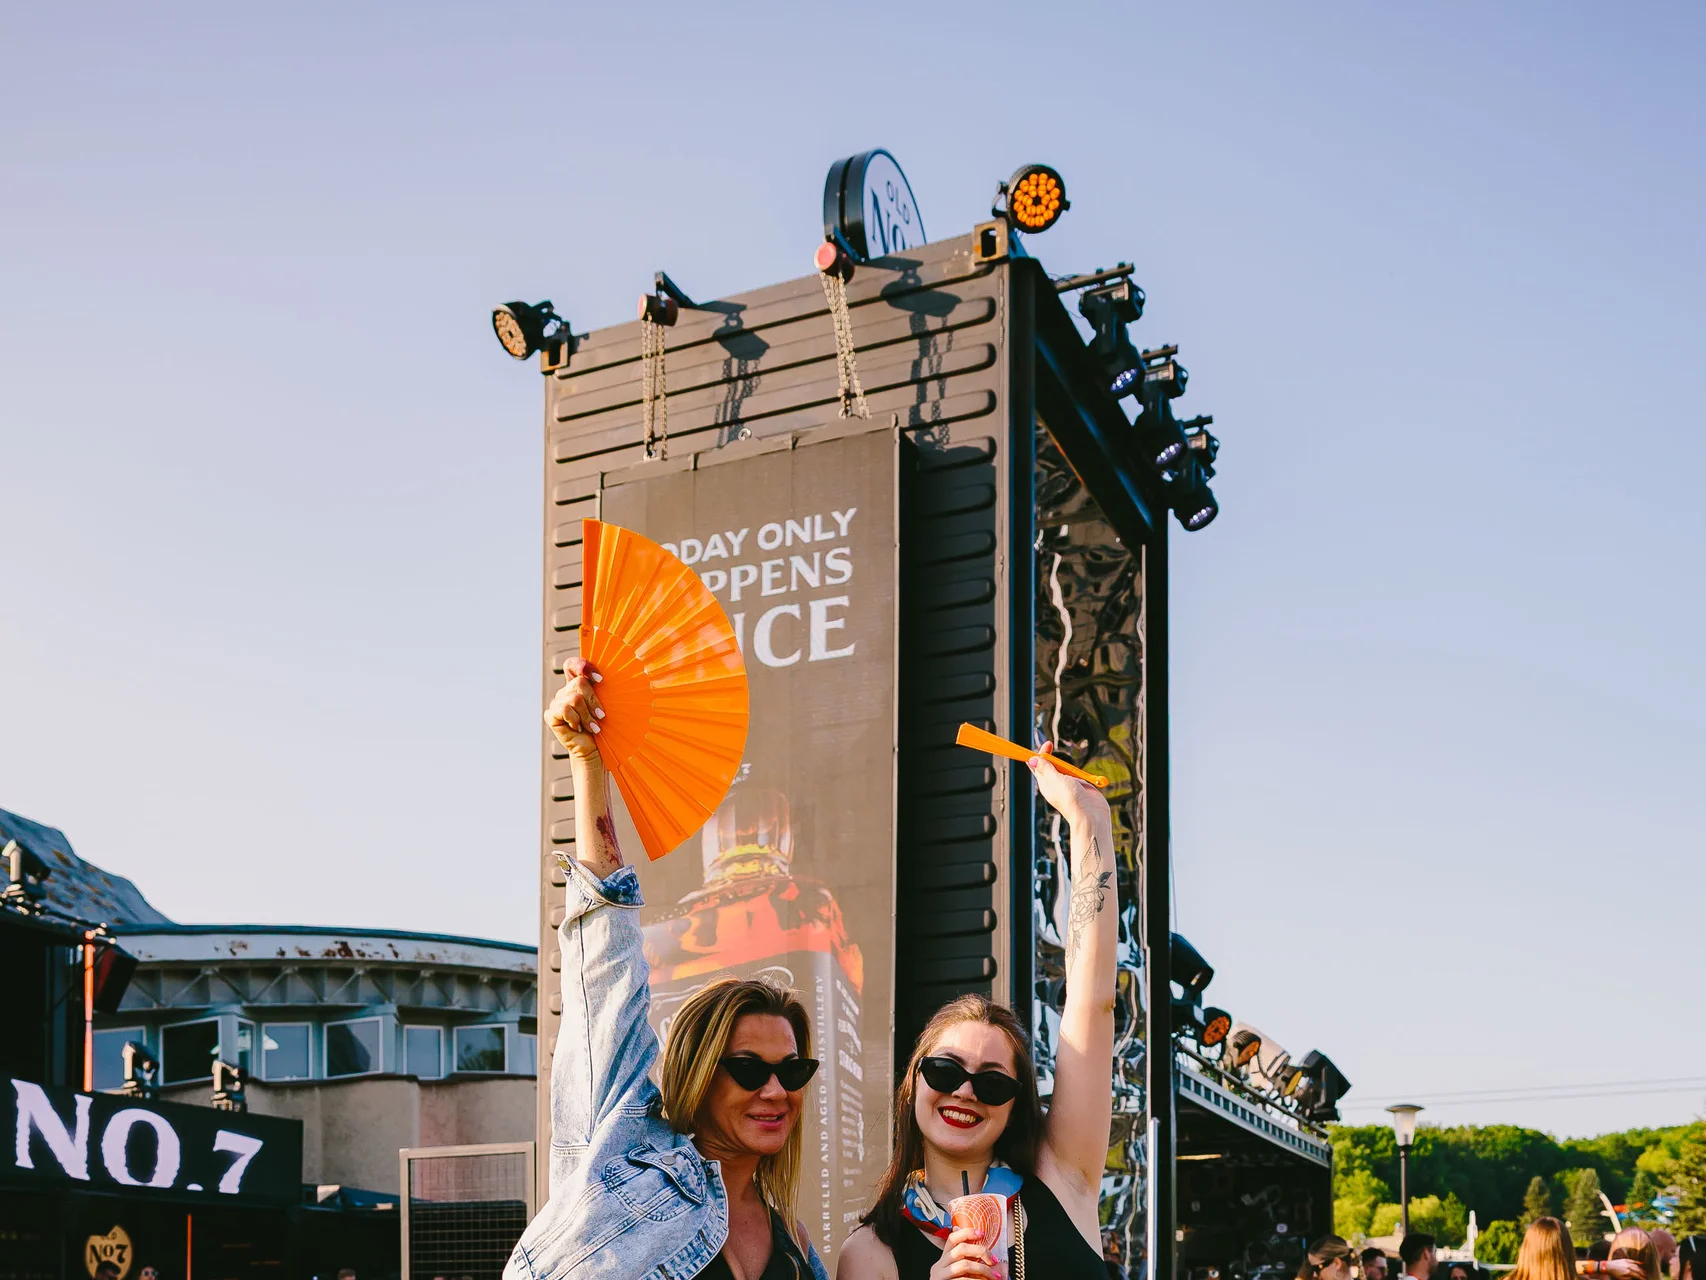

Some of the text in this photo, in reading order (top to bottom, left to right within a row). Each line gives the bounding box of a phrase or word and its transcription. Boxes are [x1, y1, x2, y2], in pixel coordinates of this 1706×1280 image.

[885, 180, 911, 225] OLD
[659, 507, 858, 566] ODAY ONLY
[700, 546, 854, 603] PPENS
[815, 975, 827, 1063] DISTILLERY
[818, 1084, 829, 1126] AGED
[819, 1130, 830, 1163] AND
[820, 1167, 832, 1254] BARRELED
